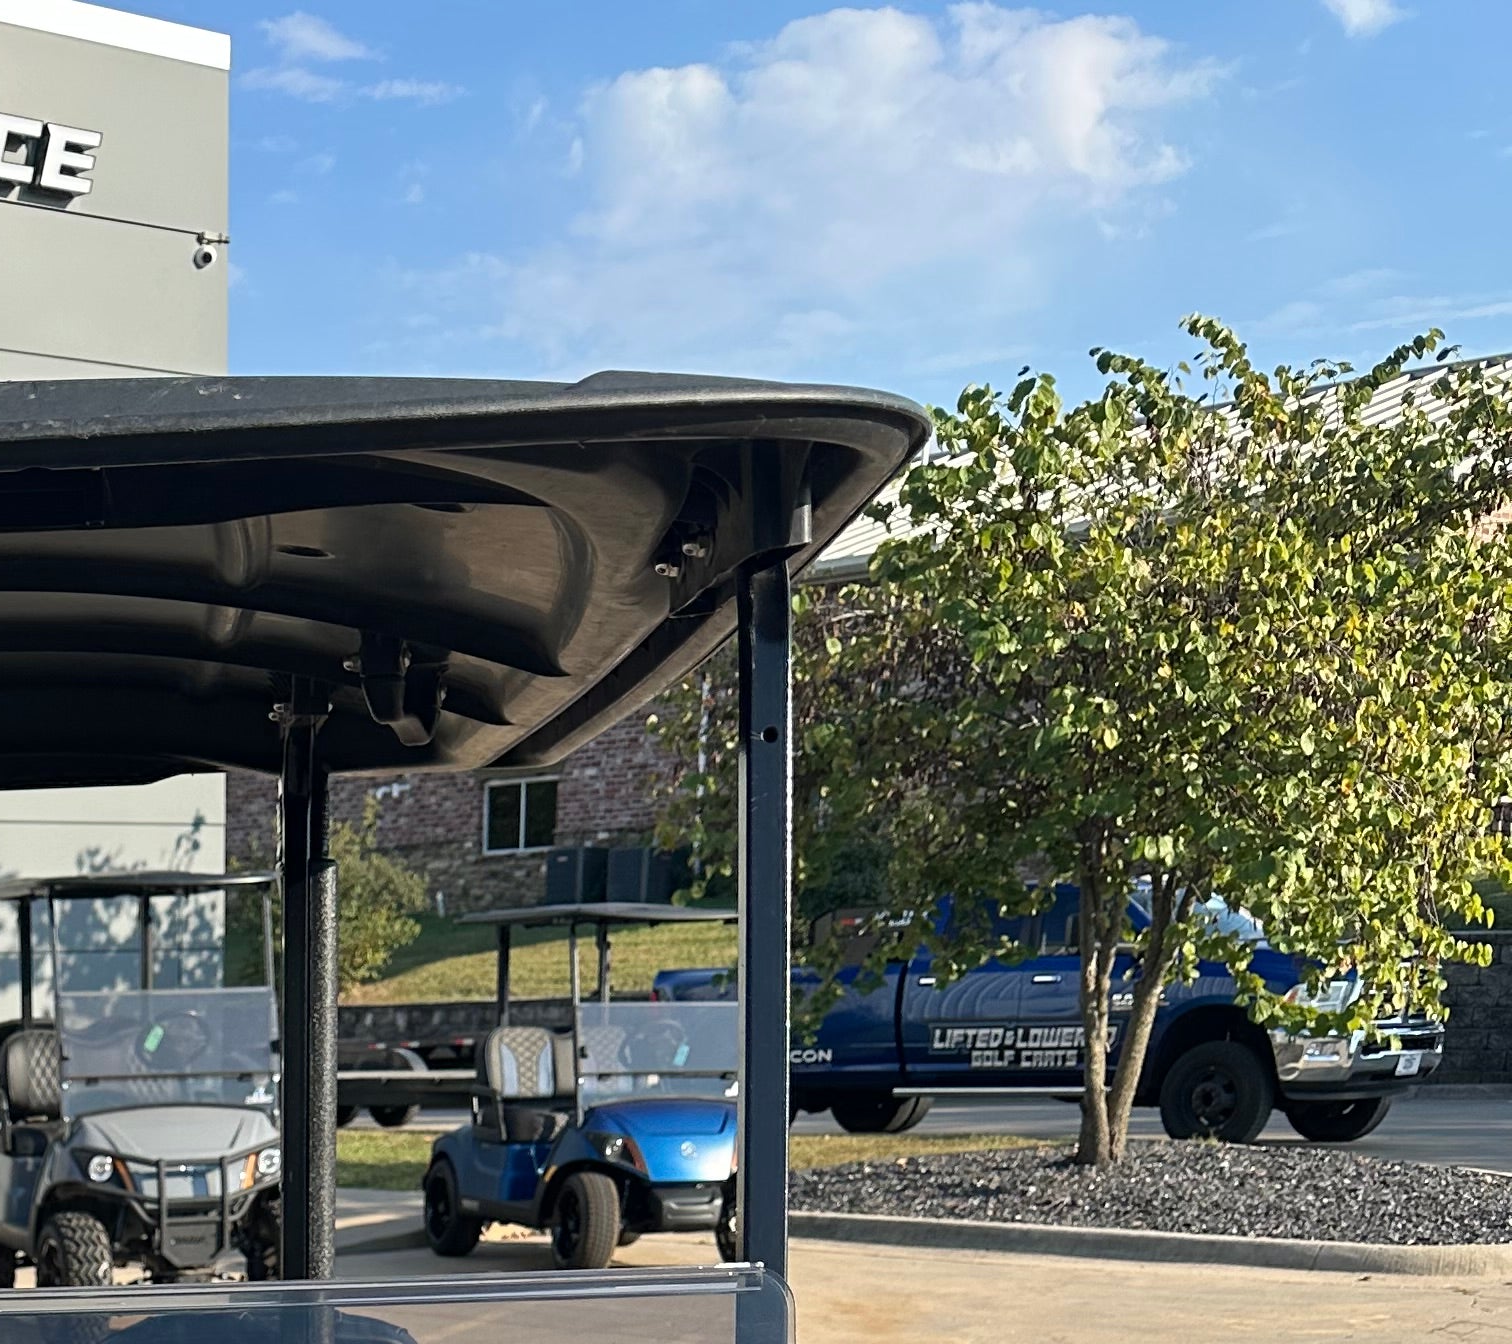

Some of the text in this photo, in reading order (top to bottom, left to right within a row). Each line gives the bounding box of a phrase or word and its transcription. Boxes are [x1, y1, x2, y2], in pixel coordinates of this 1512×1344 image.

[933, 1027, 1004, 1048] LIFTED
[1015, 1026, 1118, 1048] LOWERD
[789, 1048, 833, 1063] CON
[971, 1050, 1078, 1067] GOLF CARTS
